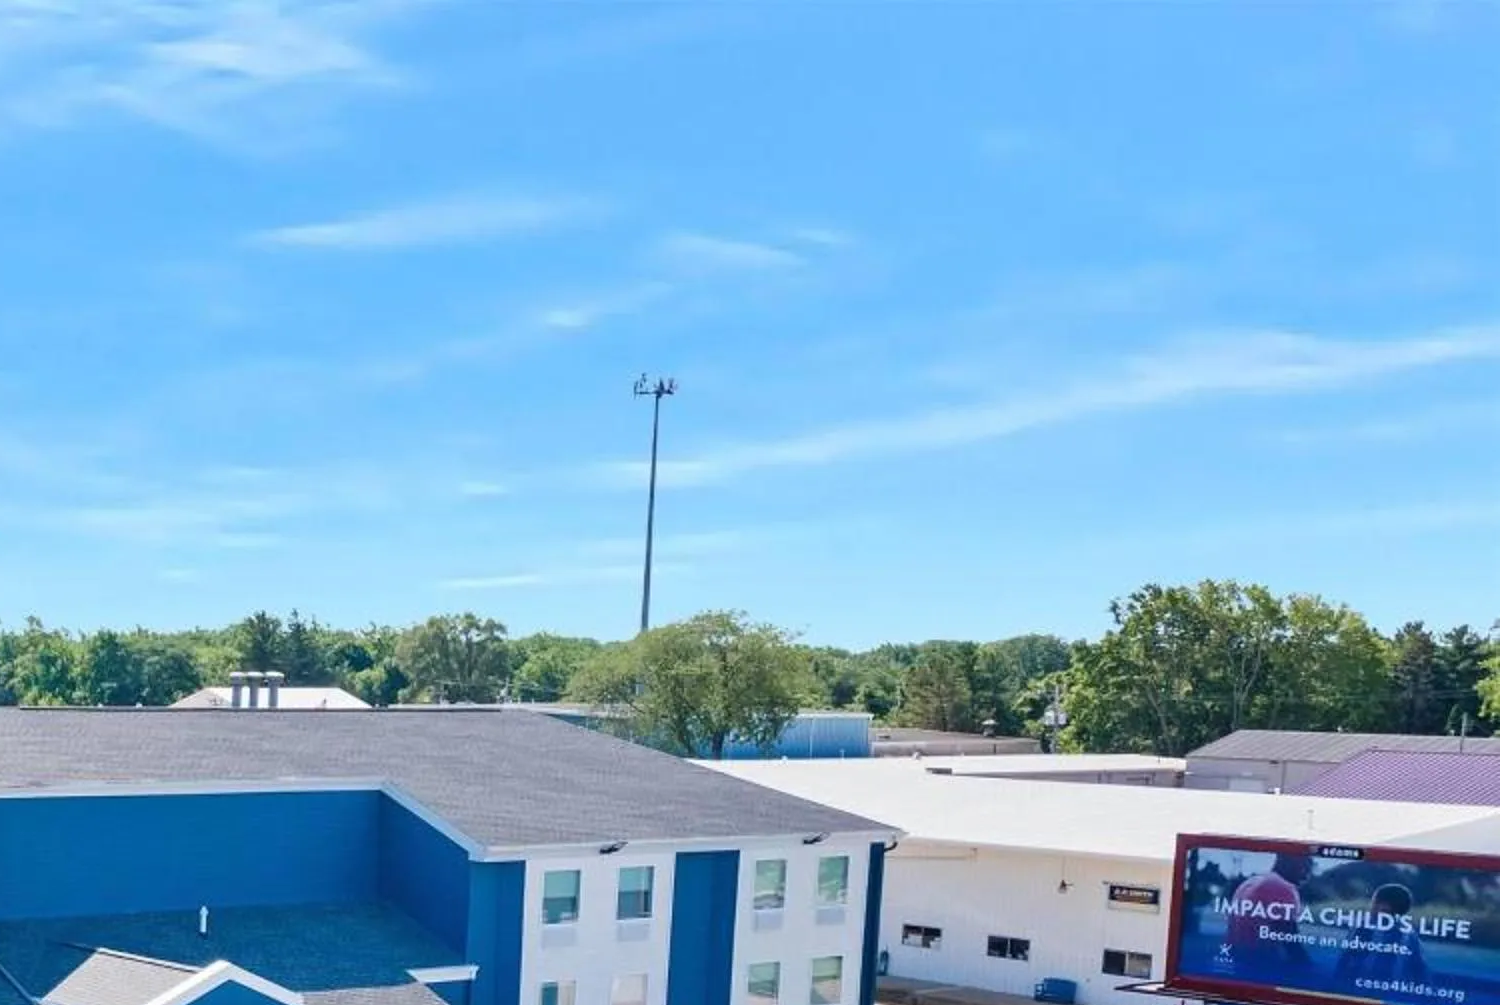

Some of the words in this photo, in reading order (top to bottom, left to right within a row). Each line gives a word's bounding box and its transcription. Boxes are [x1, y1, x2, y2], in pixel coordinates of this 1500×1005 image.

[1214, 896, 1295, 921] IMPACT
[1297, 907, 1314, 924] A
[1319, 907, 1414, 934] CHILD'S
[1419, 916, 1472, 940] LIFE
[1259, 925, 1316, 946] Become
[1319, 936, 1337, 948] an
[1341, 935, 1413, 956] advocate.
